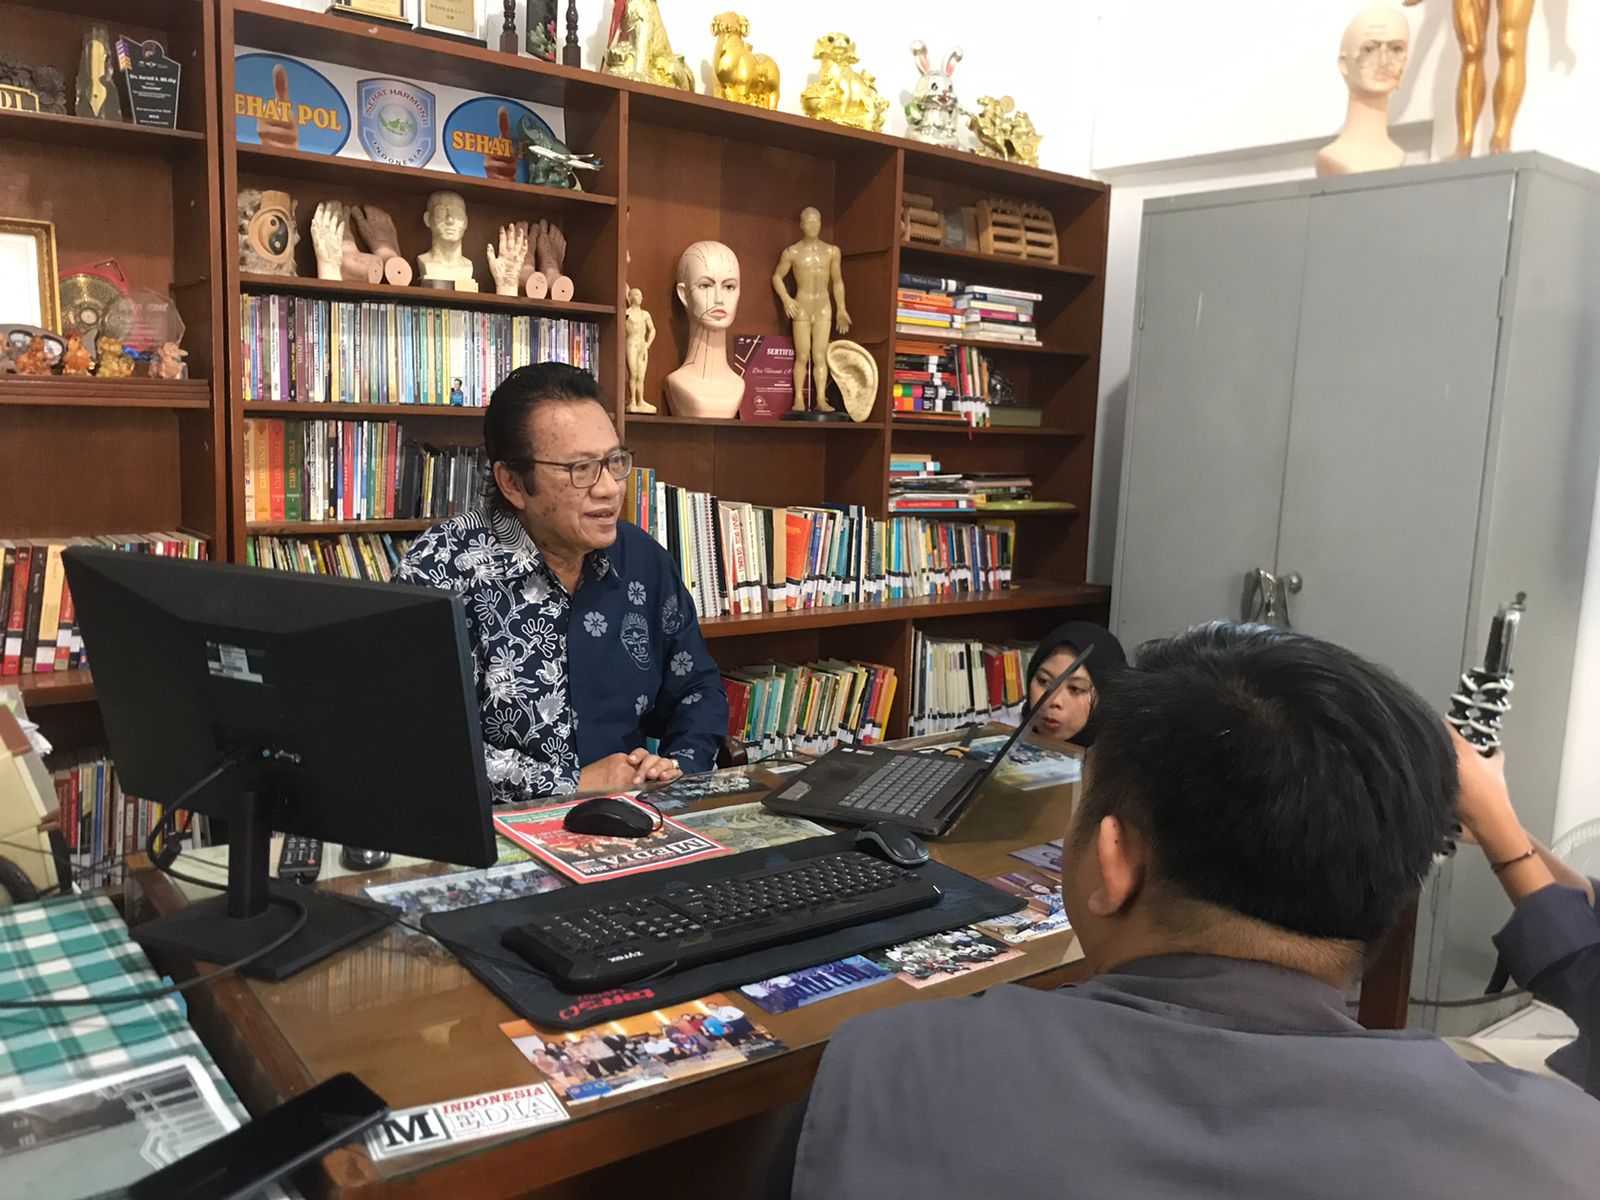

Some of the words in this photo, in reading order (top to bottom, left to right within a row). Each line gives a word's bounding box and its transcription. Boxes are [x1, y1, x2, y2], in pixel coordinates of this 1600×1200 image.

[234, 93, 292, 123] EHAT
[298, 104, 342, 131] POL
[366, 88, 387, 113] SEHAT
[389, 88, 428, 124] HARMONI
[452, 130, 513, 158] SEHAT
[442, 1086, 545, 1114] INDONESIA
